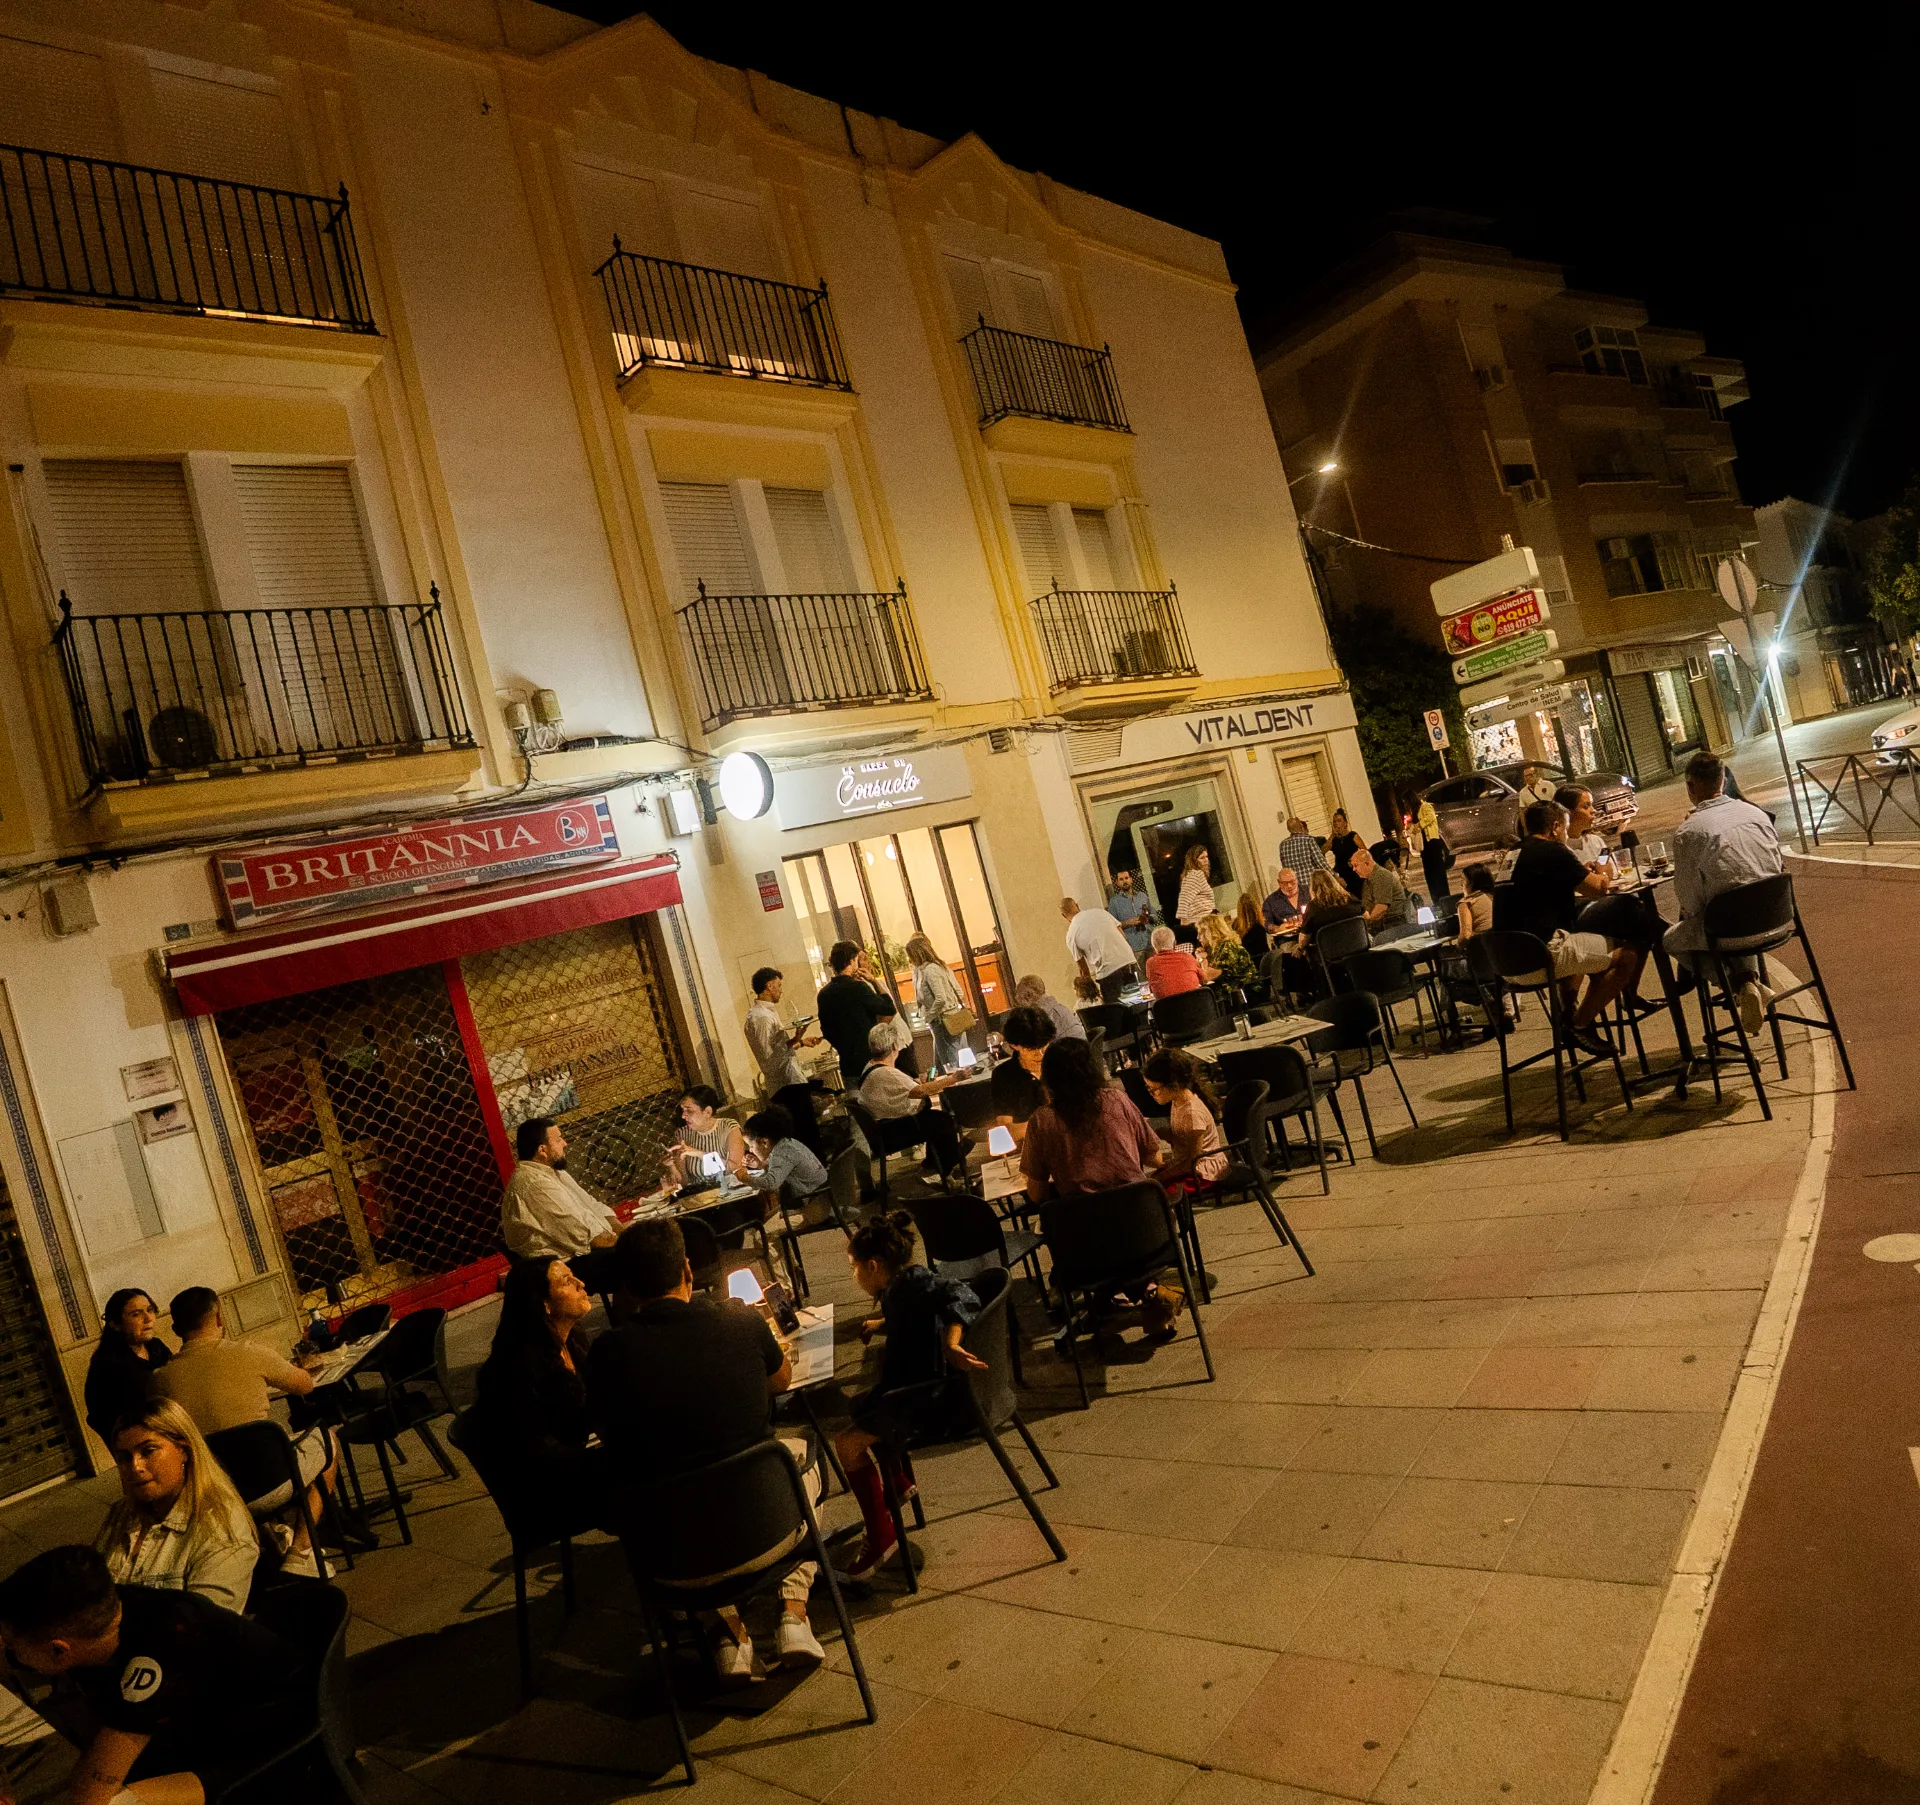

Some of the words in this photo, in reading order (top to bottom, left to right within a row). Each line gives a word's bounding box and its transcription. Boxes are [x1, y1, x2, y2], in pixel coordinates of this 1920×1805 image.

[1497, 601, 1534, 625] AQUÍ
[1507, 700, 1528, 710] Centro
[1540, 689, 1559, 700] Salud
[1542, 696, 1561, 706] INEM
[1185, 704, 1314, 745] VITALDENT
[842, 766, 854, 775] LA
[837, 763, 920, 806] Consuelo
[381, 833, 425, 846] ACADEMIA
[259, 824, 541, 892] BRITANNIA
[369, 869, 410, 883] SCHOOL
[412, 866, 424, 876] OF
[427, 859, 467, 873] ENGLISH
[123, 1667, 157, 1690] JD
